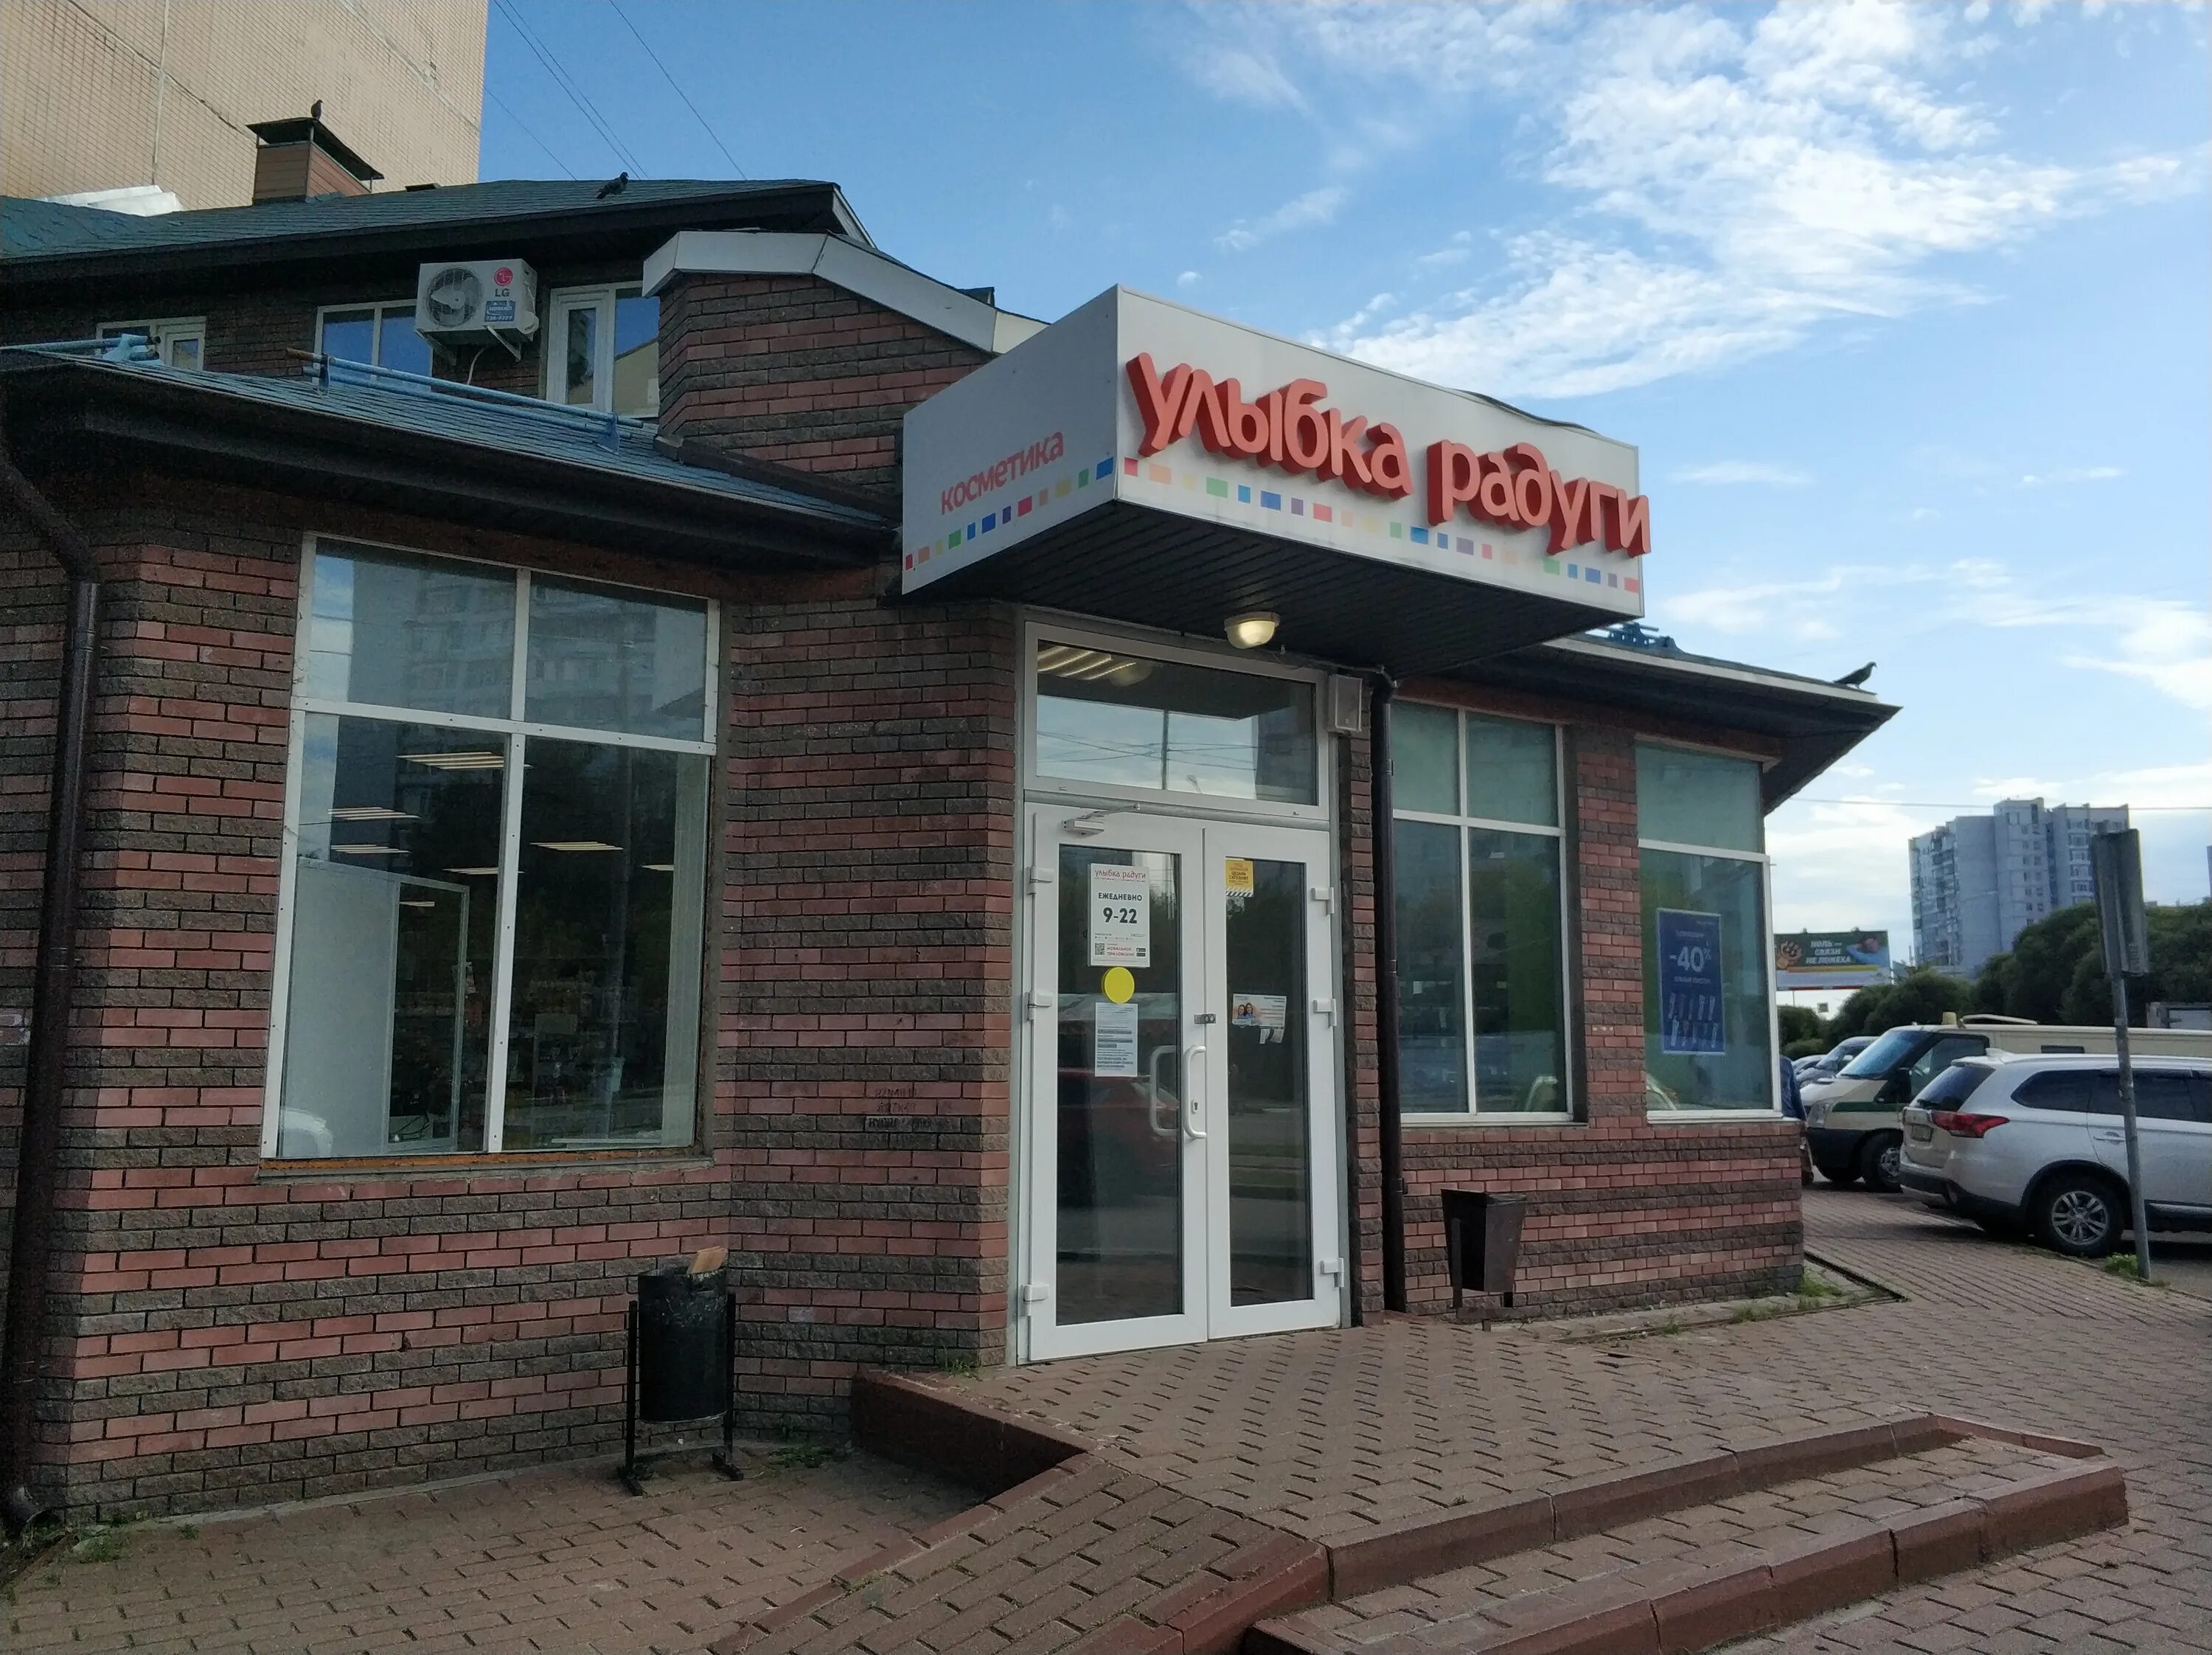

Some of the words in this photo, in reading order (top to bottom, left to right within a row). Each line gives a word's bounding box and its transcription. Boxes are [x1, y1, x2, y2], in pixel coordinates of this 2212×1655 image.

[495, 288, 509, 297] LG
[1127, 351, 1413, 501] улыбка
[1426, 437, 1652, 559] радуги
[941, 431, 1064, 515] косметика
[1094, 869, 1121, 878] улыбка
[1122, 870, 1147, 879] радуги
[1098, 892, 1143, 901] ЕЖЕДНЕВНО
[1102, 906, 1138, 924] 9-22
[1815, 948, 1841, 956] СВЯЗИ
[1669, 946, 1711, 973] -40%
[1806, 957, 1818, 965] НЕ
